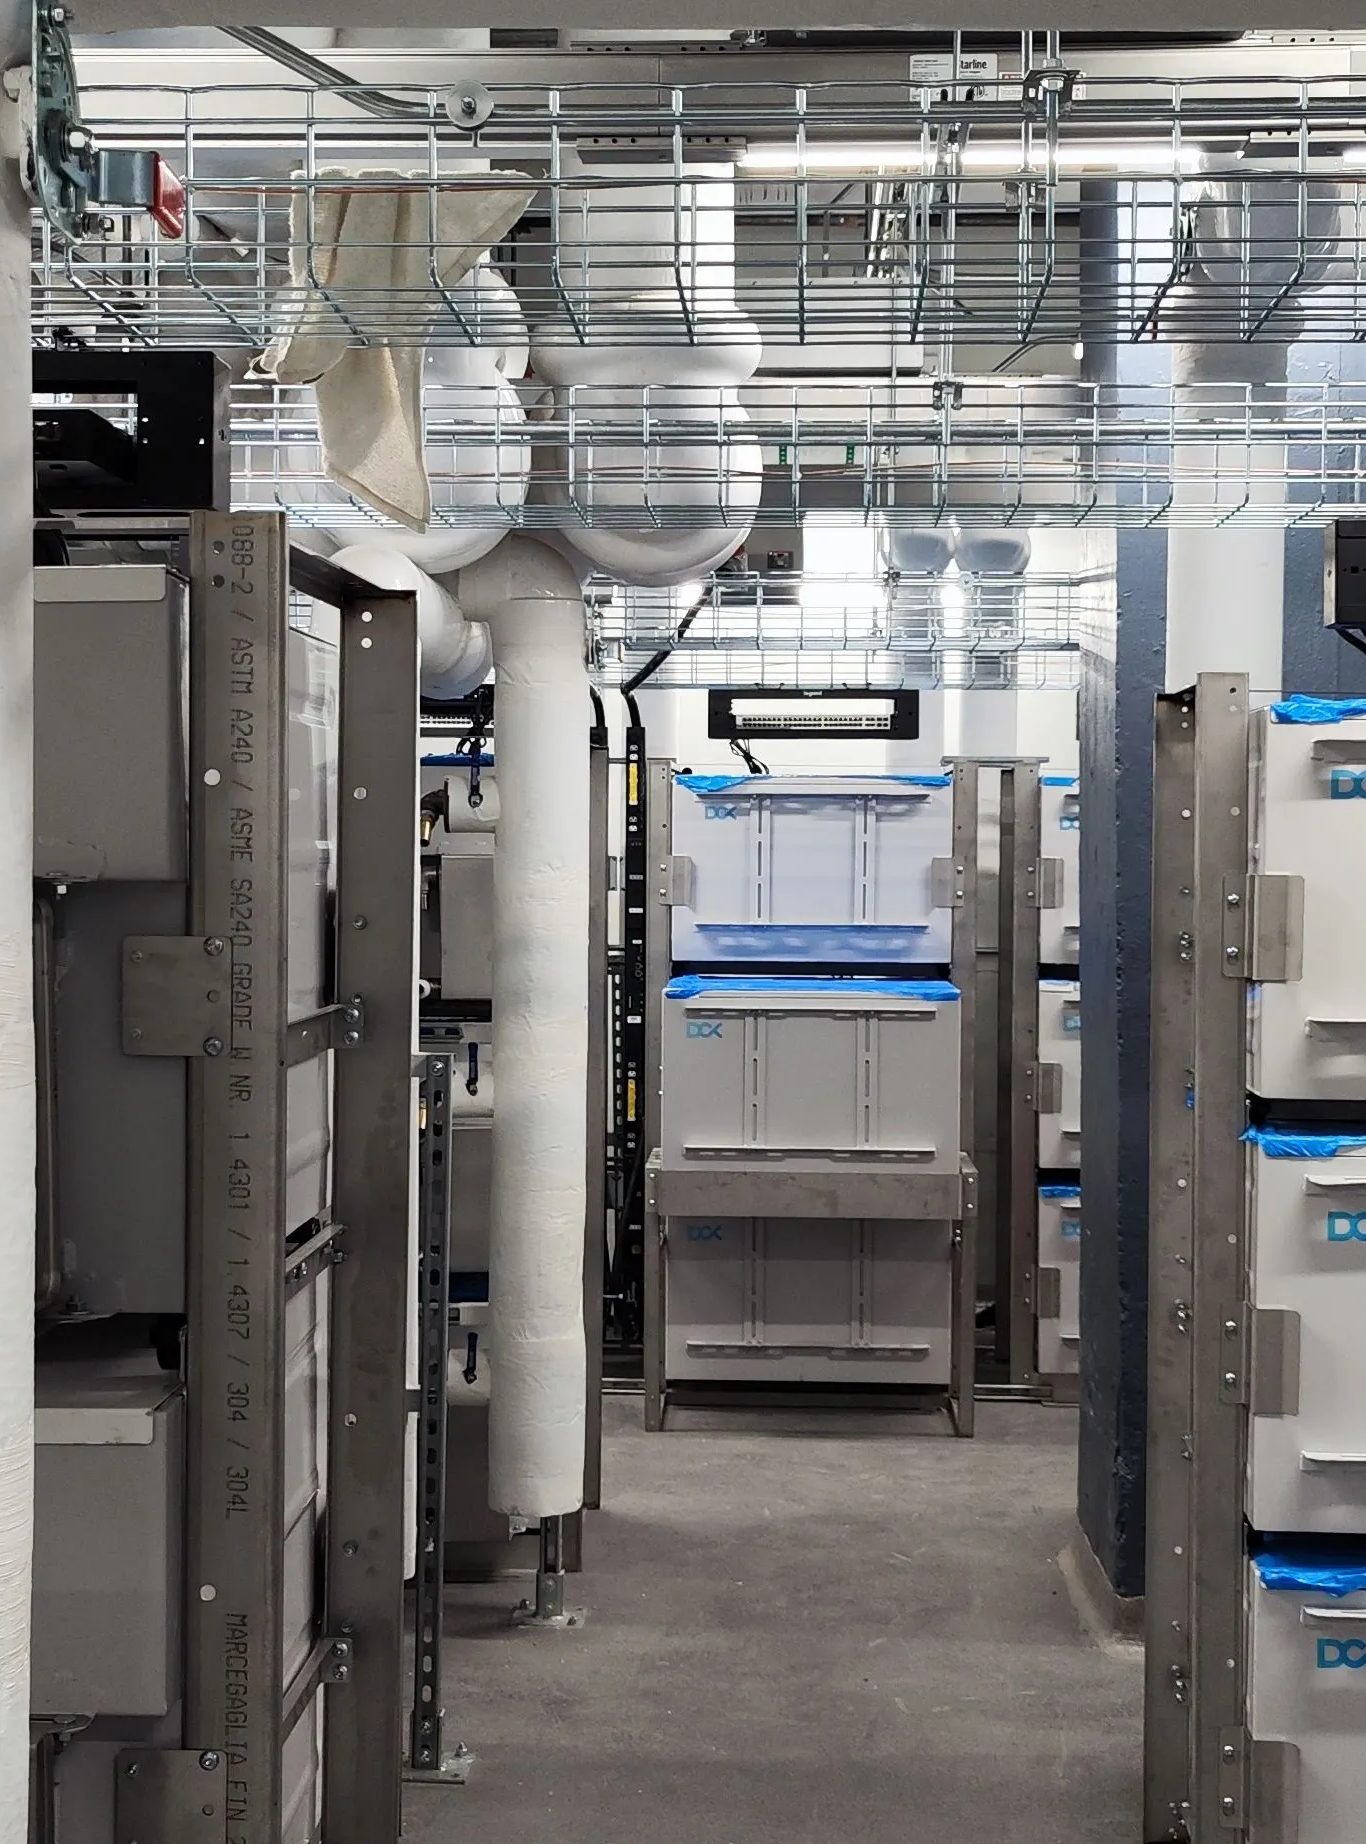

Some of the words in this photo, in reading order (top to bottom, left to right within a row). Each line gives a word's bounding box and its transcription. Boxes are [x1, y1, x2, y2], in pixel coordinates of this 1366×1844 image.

[231, 638, 254, 695] ASTM
[231, 708, 254, 764] A240
[230, 808, 254, 862] ASME
[230, 879, 253, 947] SA240
[232, 962, 252, 1032] GRADE
[229, 1075, 252, 1102] NR
[228, 1228, 252, 1241] /
[227, 1354, 251, 1367] /
[227, 1382, 250, 1422] 304
[227, 1437, 250, 1450] /
[226, 1466, 250, 1520] 304L
[225, 1614, 249, 1766] MARCEGAGLIA
[227, 1780, 248, 1821] FIN
